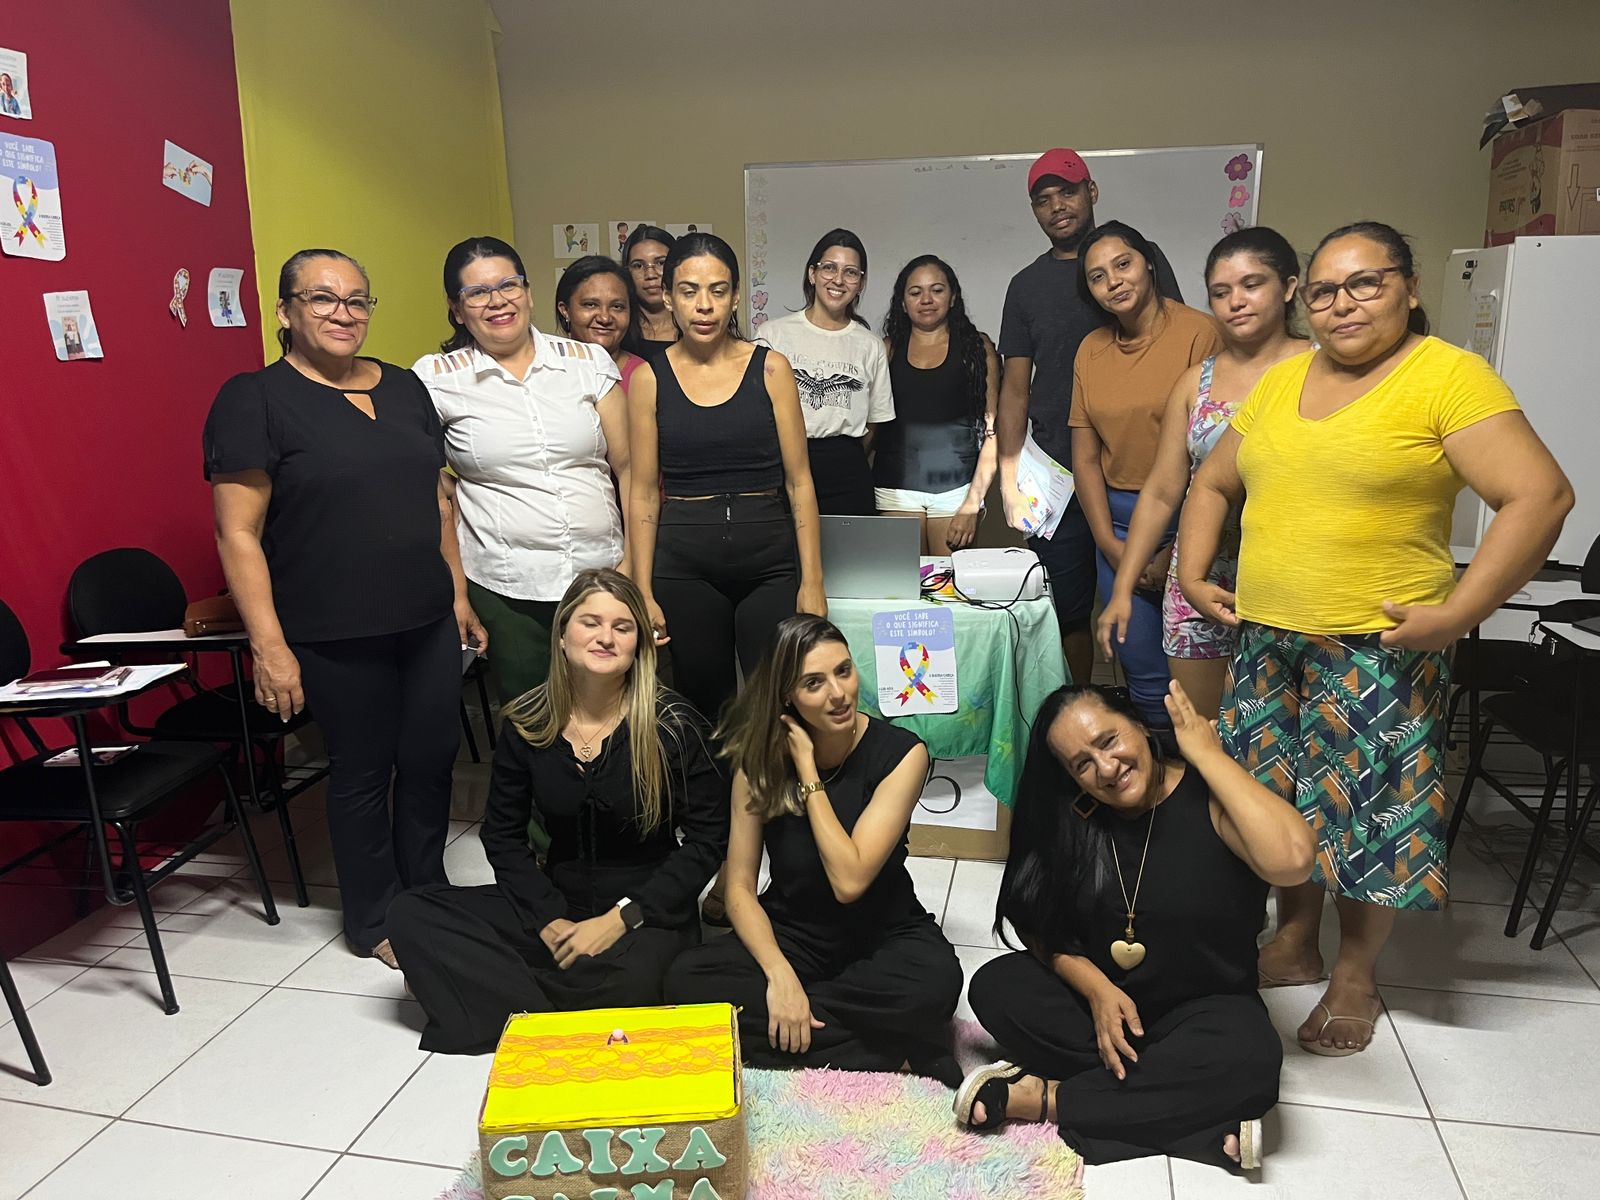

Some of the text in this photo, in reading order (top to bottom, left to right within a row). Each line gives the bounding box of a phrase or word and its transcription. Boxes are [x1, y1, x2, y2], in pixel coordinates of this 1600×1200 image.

[894, 611, 929, 621] VOCÊ SABE
[893, 621, 906, 629] QUE
[908, 620, 939, 629] SIGNIFICA
[889, 628, 936, 637] ESTE SÍMBOLO?
[488, 1126, 727, 1177] CAIXA
